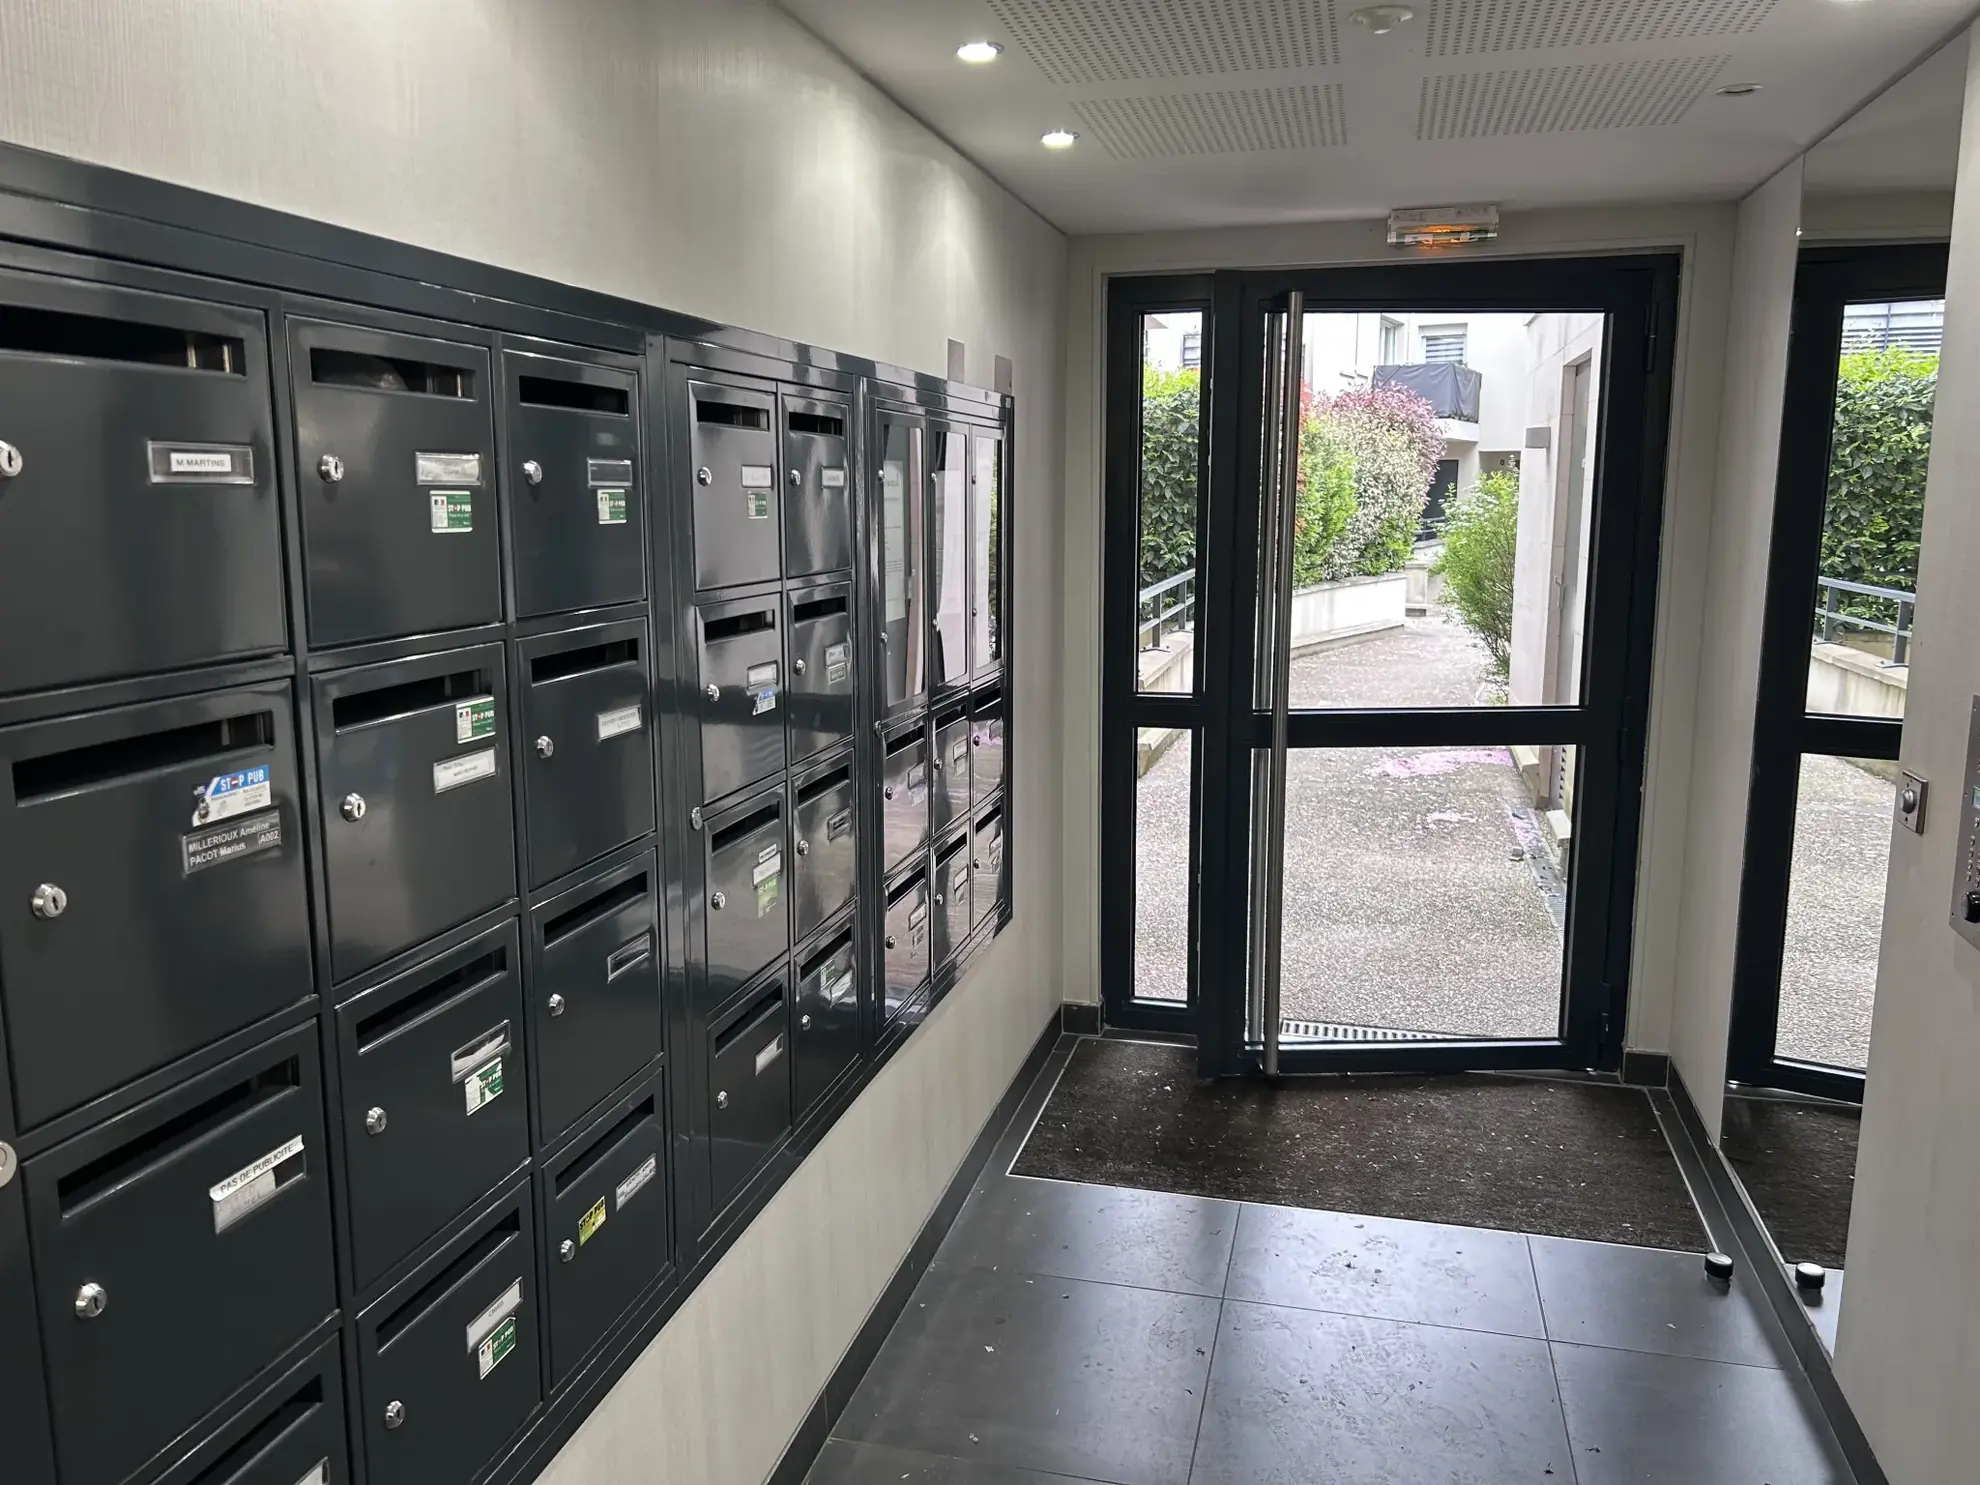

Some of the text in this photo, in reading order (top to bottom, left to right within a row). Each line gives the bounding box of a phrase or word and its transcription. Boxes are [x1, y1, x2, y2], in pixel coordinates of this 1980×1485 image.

[186, 459, 226, 468] MARTINS
[247, 769, 265, 784] PUB
[188, 829, 239, 854] MILLERIOUX
[260, 830, 280, 844] A002
[190, 842, 246, 867] PACOT Marius
[220, 1143, 294, 1194] PAS DE PUBLICITE
